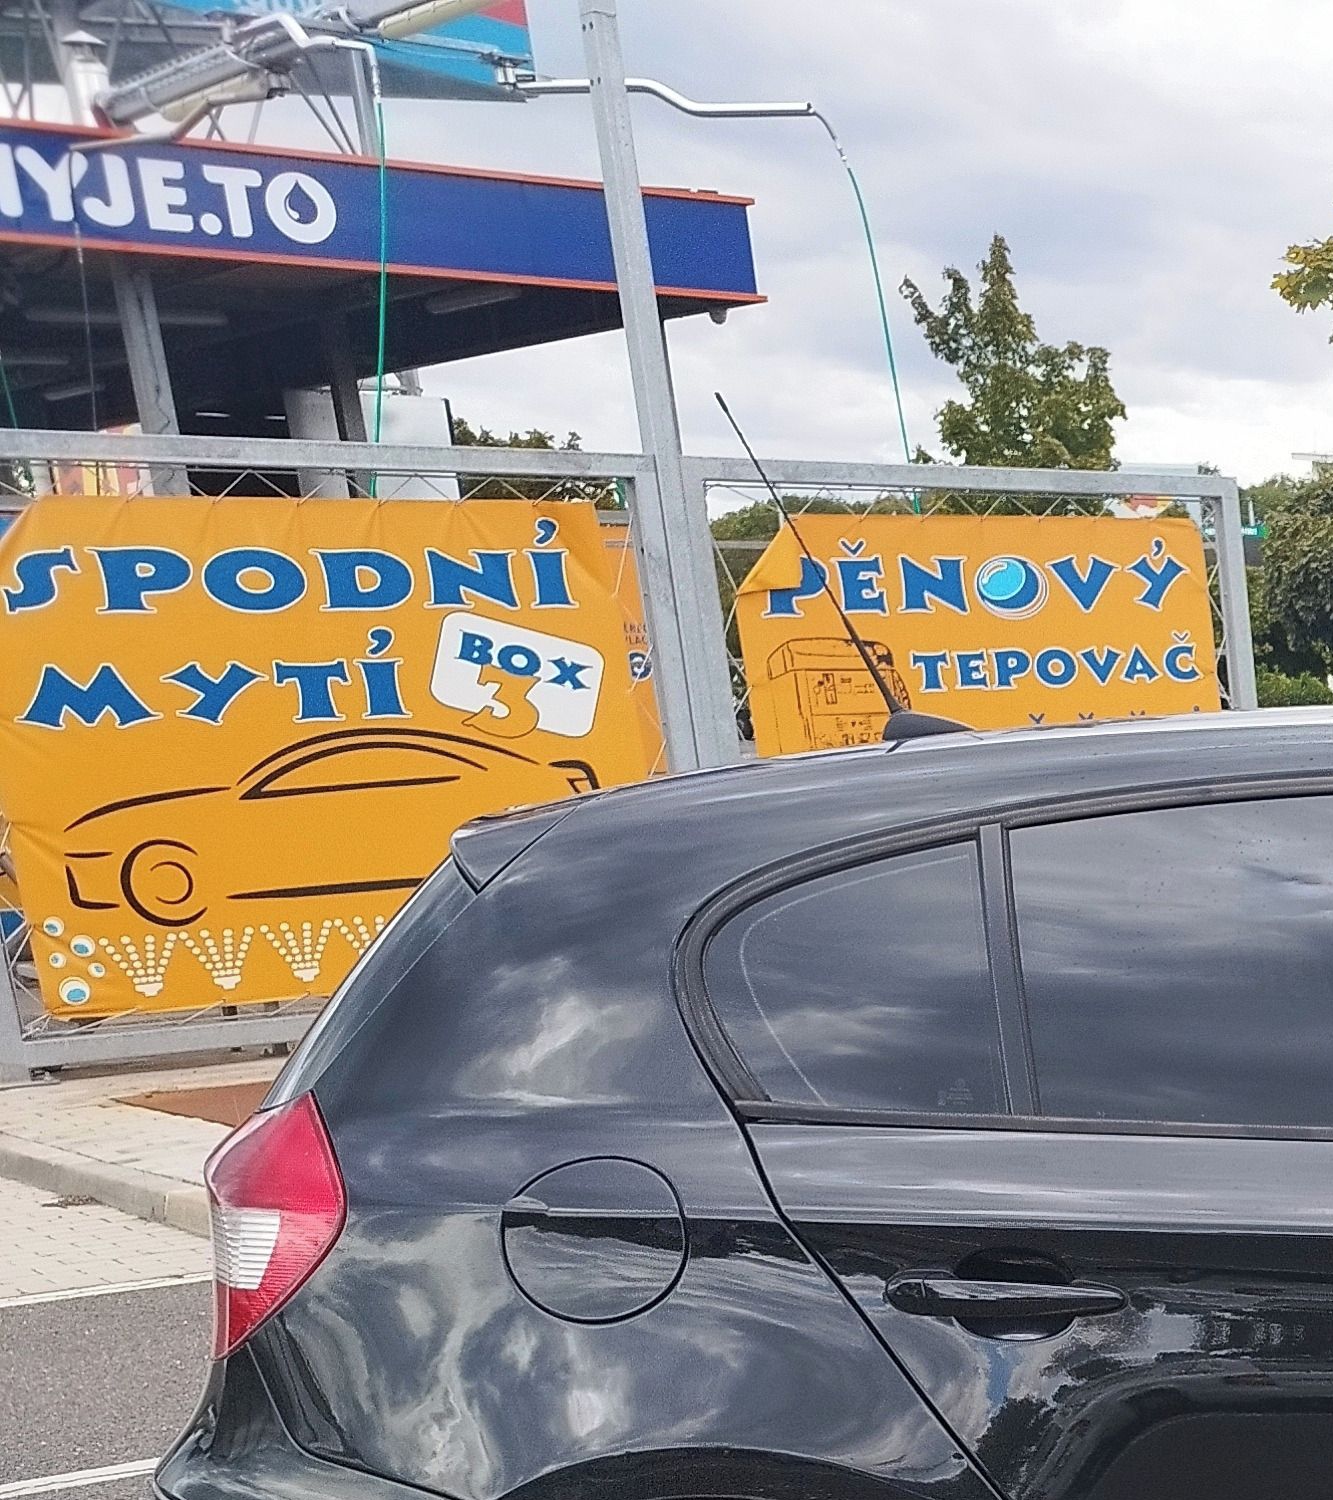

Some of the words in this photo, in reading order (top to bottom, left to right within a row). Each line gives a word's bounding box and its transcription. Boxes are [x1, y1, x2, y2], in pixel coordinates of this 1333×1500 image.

[2, 518, 579, 615] SPODNÍ
[763, 537, 1190, 620] PĚNOVÝ
[15, 627, 412, 730] MYTÍ
[455, 629, 593, 691] BOX
[910, 630, 1205, 693] TEPOVAČ
[461, 664, 542, 739] 3
